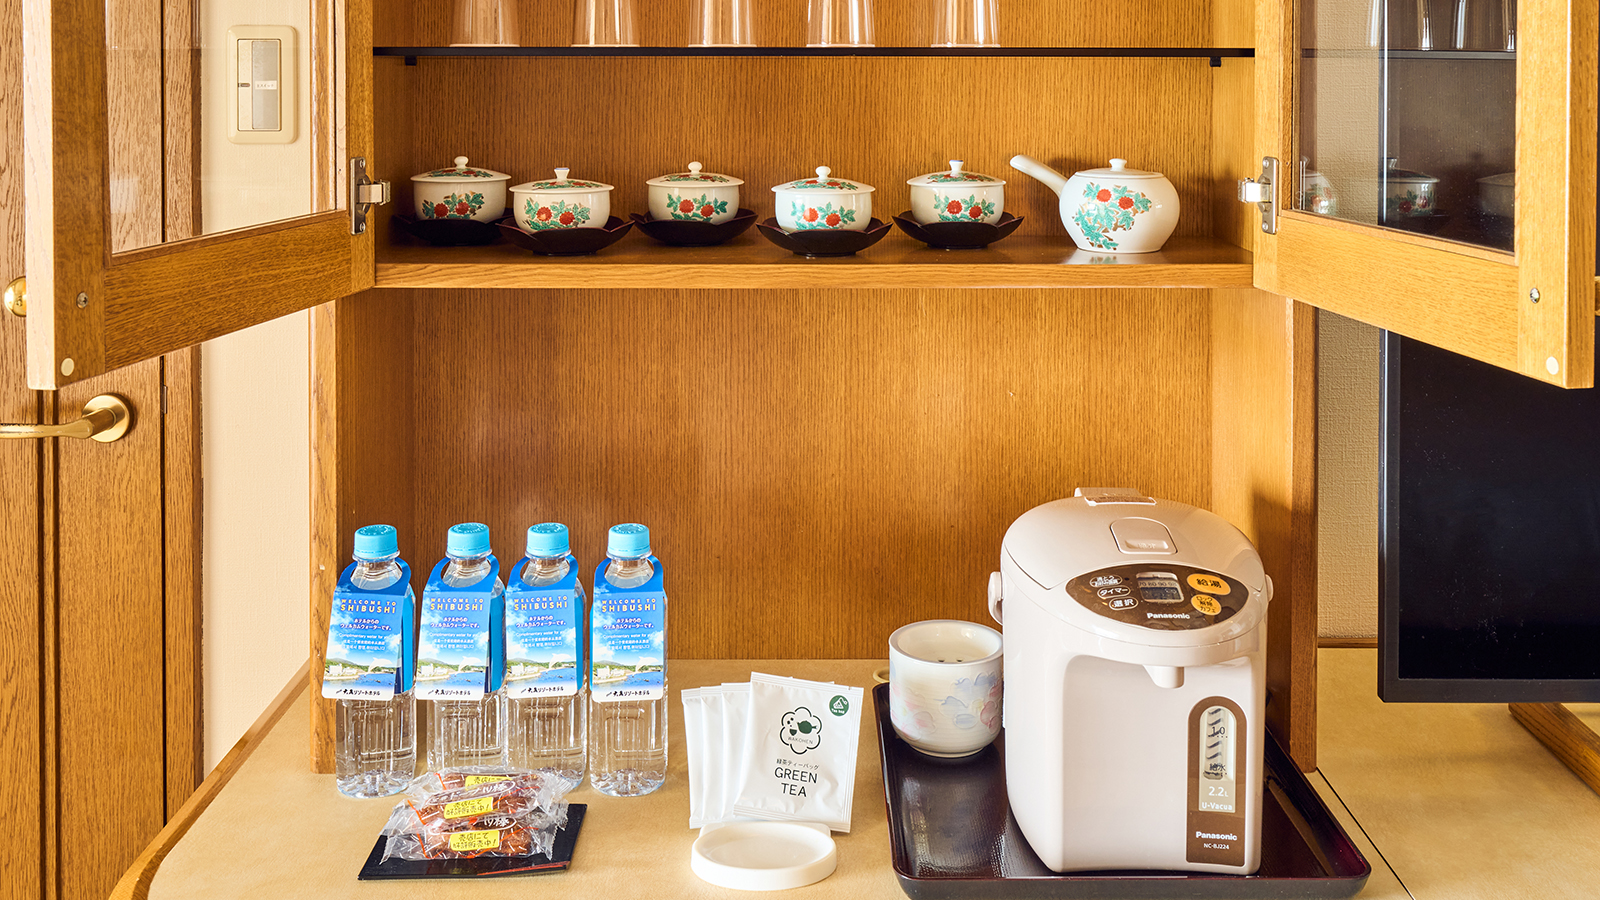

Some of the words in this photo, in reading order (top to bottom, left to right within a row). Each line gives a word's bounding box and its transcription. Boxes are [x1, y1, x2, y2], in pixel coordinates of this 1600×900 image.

[1196, 578, 1222, 589] 給湯
[1100, 588, 1128, 596] タイマー
[430, 603, 483, 611] SHIBUSHI
[514, 601, 568, 611] SHIBUSHI
[1113, 598, 1134, 607] 選択
[340, 604, 396, 613] SHIBUSHI
[602, 604, 656, 613] SHIBUSHI
[776, 758, 819, 771] 緑茶ティーバッグ
[774, 766, 818, 784] GREEN
[781, 782, 807, 797] TEA
[453, 799, 482, 808] 売店にて
[1201, 801, 1233, 811] U-Vacua
[459, 832, 489, 841] 売店にて
[1195, 831, 1237, 841] Panasonic
